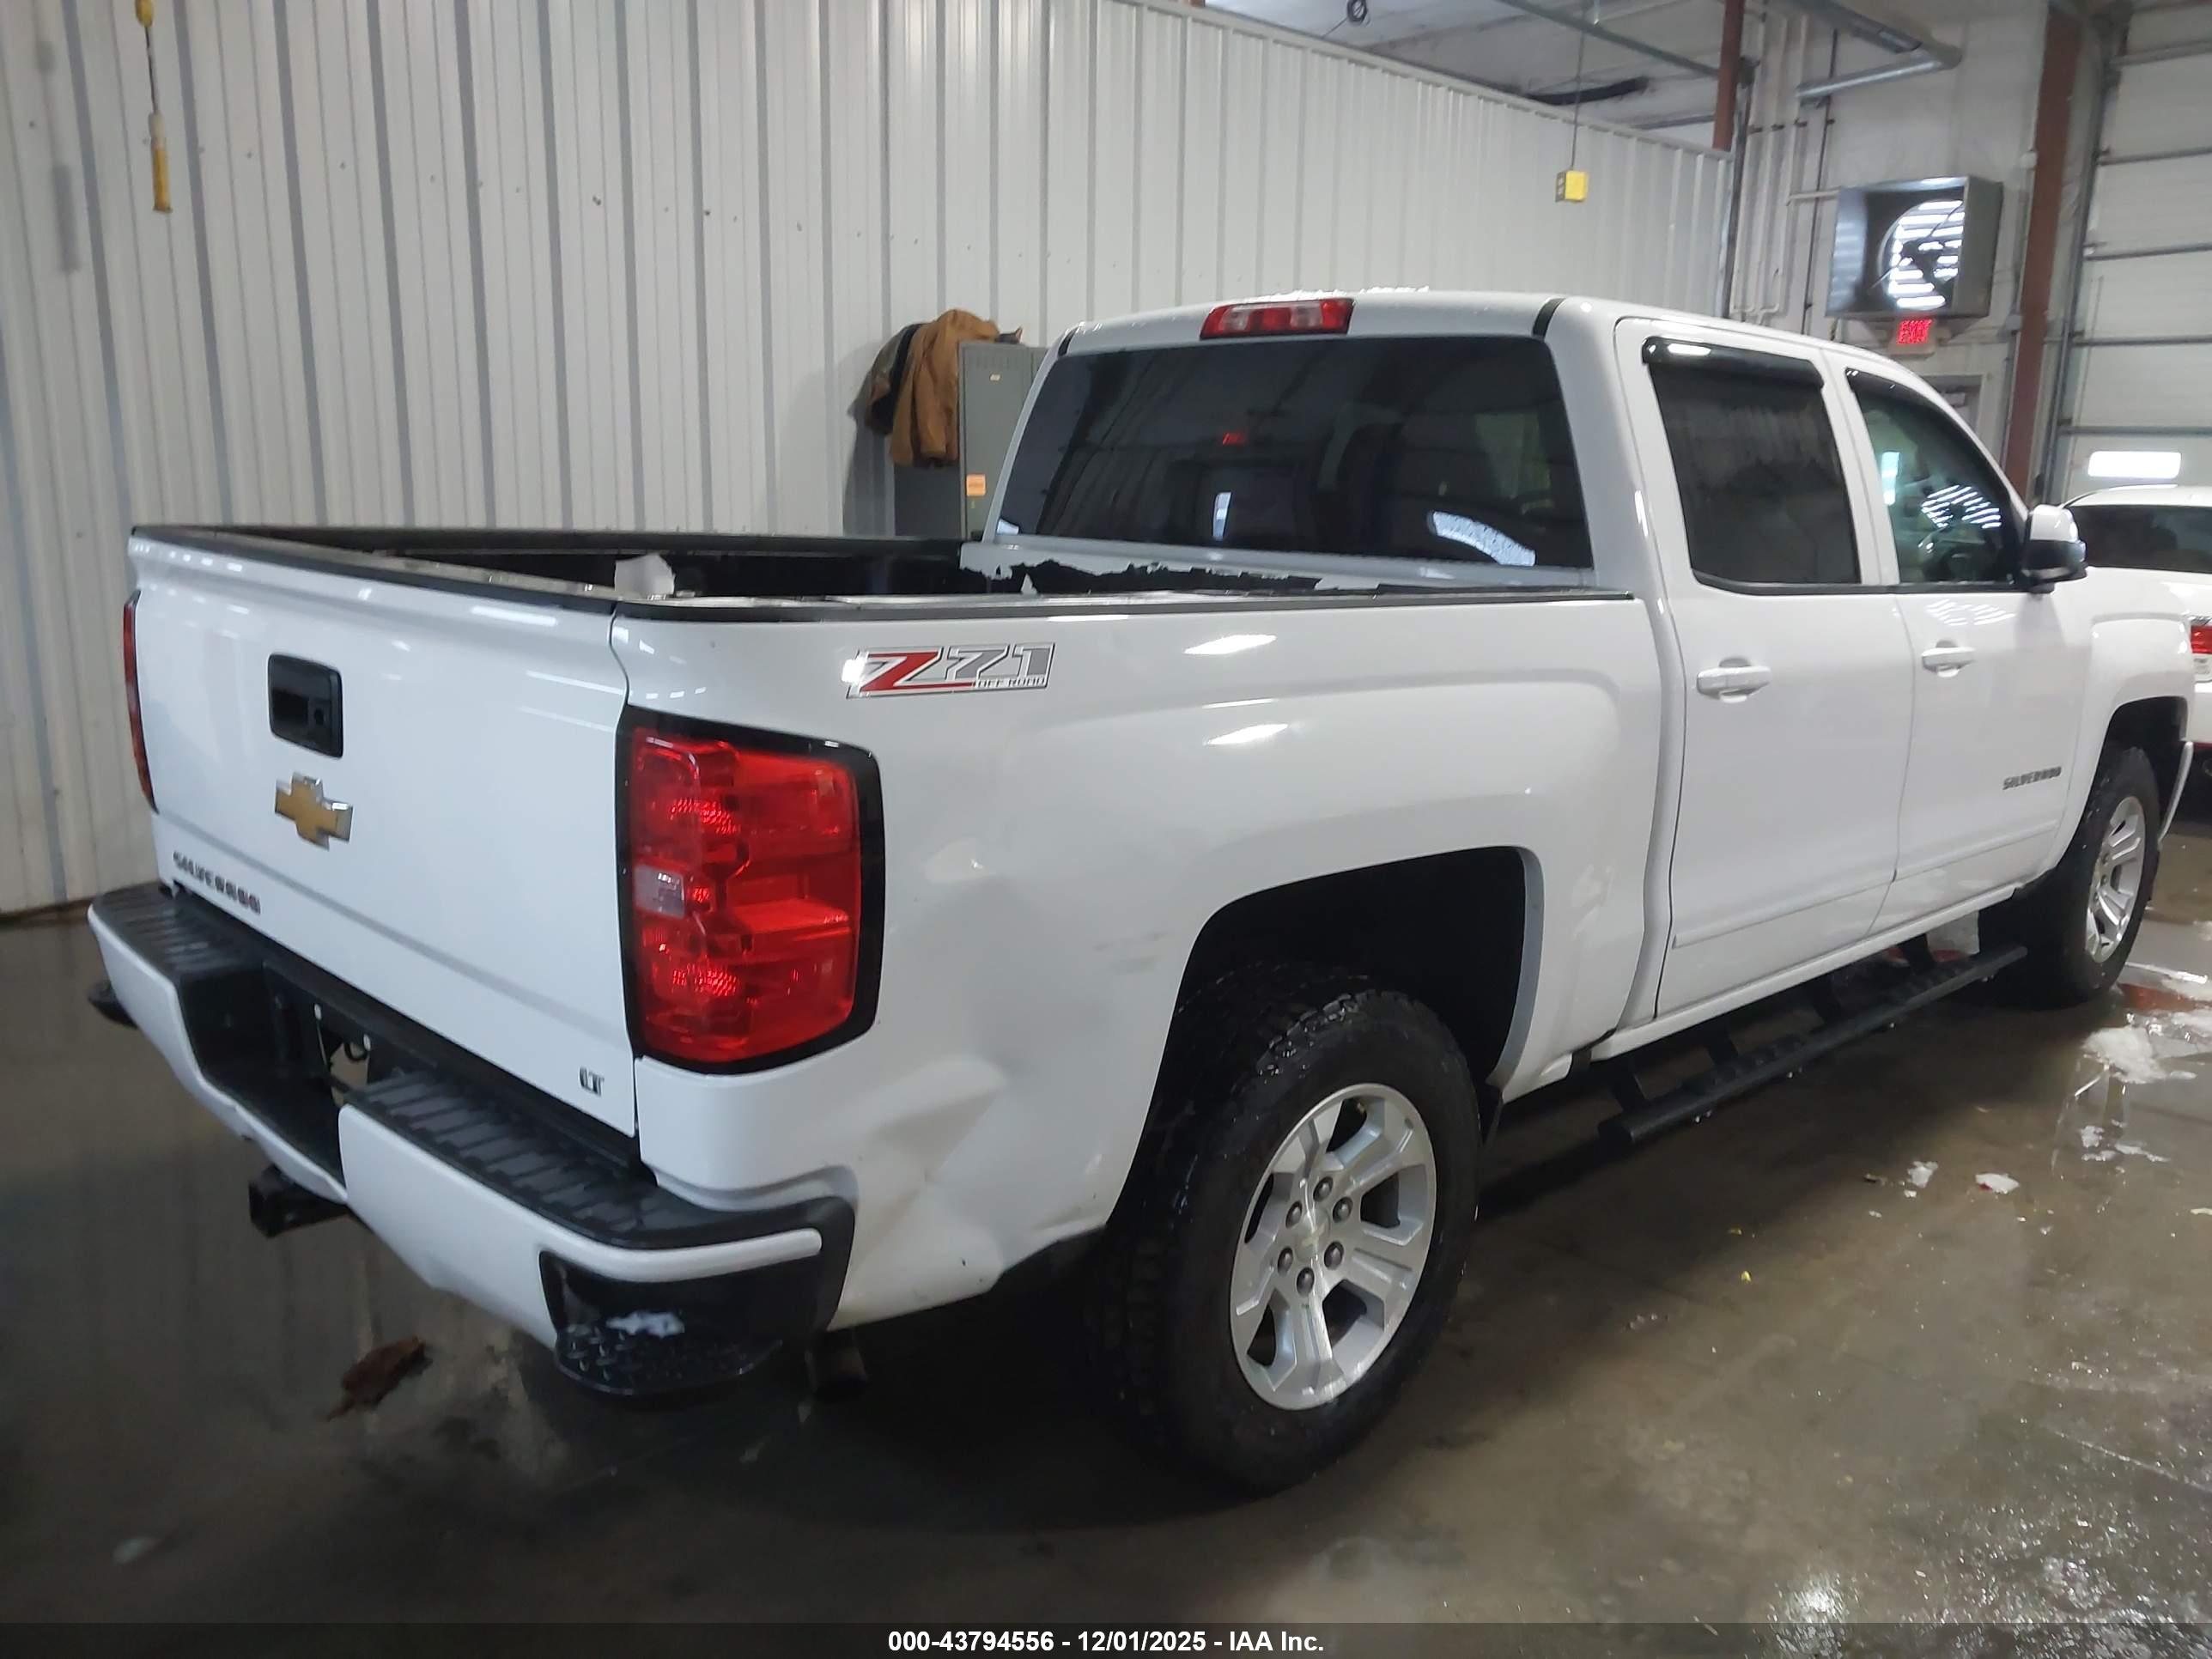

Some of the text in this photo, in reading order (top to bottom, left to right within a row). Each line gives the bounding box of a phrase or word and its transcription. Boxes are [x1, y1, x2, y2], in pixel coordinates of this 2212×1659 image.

[856, 646, 1053, 694] Z71
[2002, 766, 2063, 791] SILVERADO
[173, 851, 261, 915] SILVERADO
[579, 1066, 605, 1097] LT
